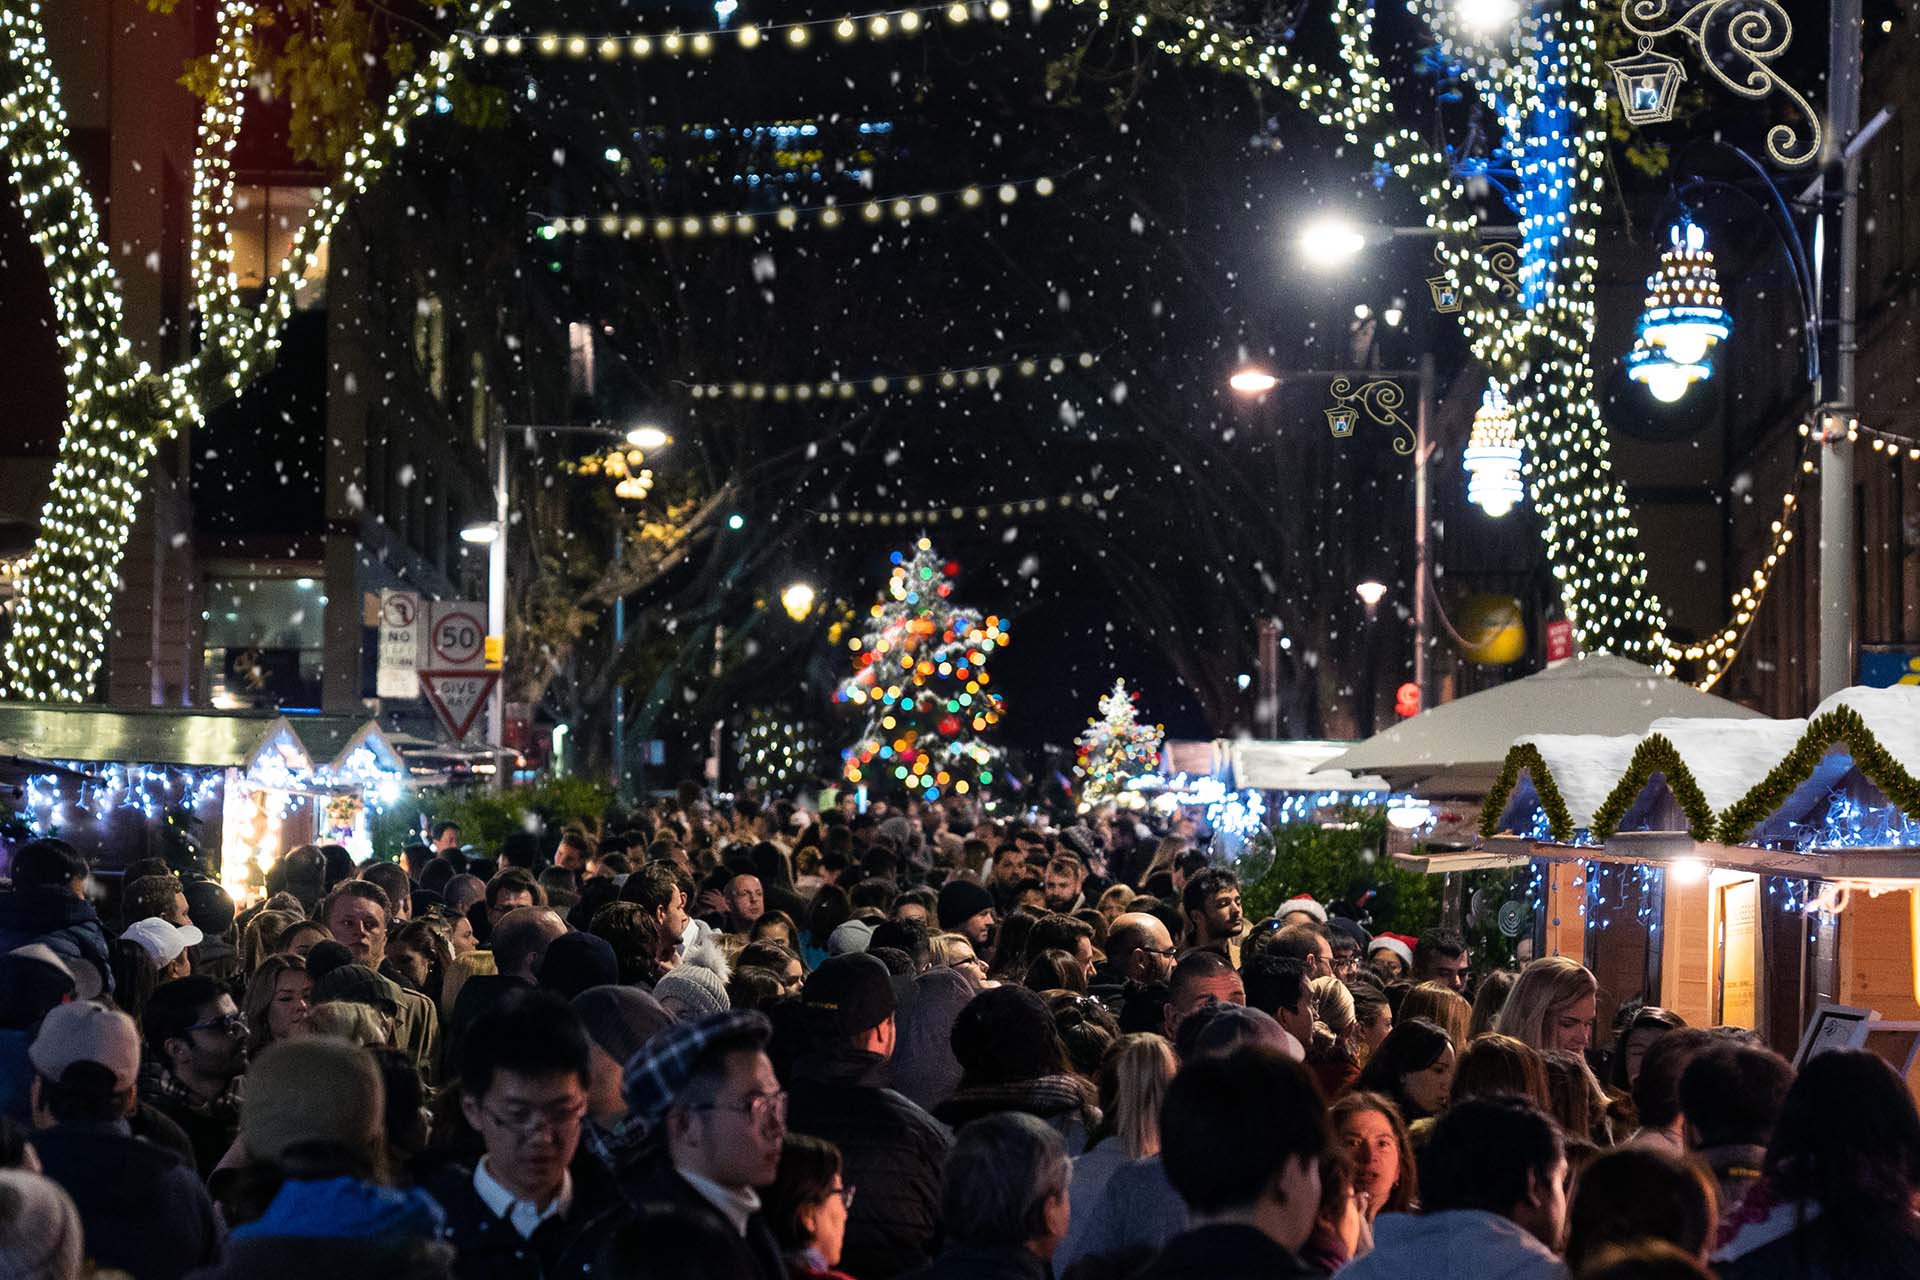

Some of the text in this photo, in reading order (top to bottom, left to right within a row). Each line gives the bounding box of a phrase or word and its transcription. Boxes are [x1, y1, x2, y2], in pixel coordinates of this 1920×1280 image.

[388, 630, 411, 643] NO
[442, 626, 475, 649] 50
[441, 680, 477, 694] GIVE
